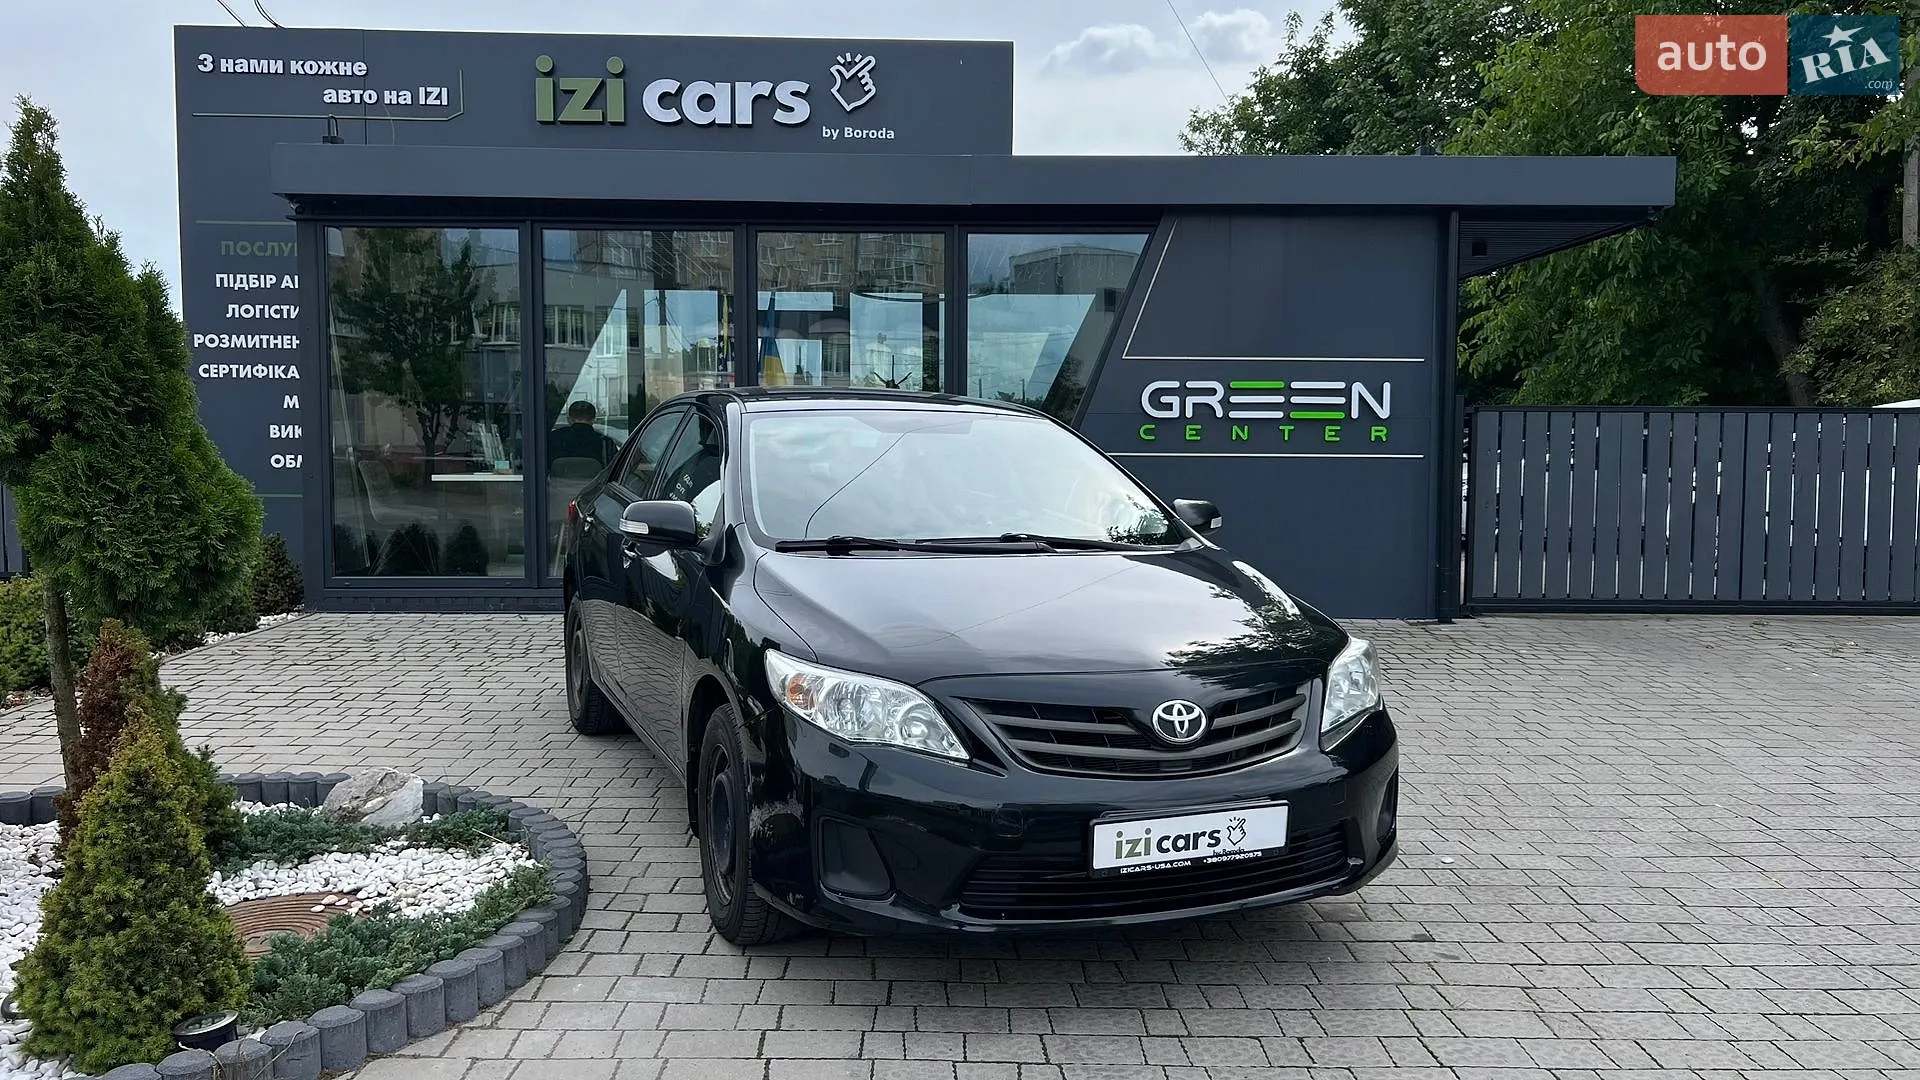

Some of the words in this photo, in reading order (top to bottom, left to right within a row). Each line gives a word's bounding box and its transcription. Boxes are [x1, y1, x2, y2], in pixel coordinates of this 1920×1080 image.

[197, 53, 214, 73] З
[220, 57, 284, 74] нами
[290, 60, 368, 76] кожне
[323, 88, 378, 104] авто
[384, 90, 412, 105] на
[419, 86, 449, 106] IZI
[535, 54, 626, 124] izi
[641, 78, 811, 125] cars
[822, 127, 839, 140] by
[844, 127, 895, 140] Boroda
[215, 273, 277, 291] ПІДБІР
[198, 363, 301, 379] СЕРТИФІКА
[1141, 380, 1391, 419] GREEN
[1139, 424, 1388, 442] CENTER
[1115, 827, 1152, 860] izi
[1156, 829, 1221, 853] cars
[1120, 860, 1192, 874] IZICARS-USA.COM
